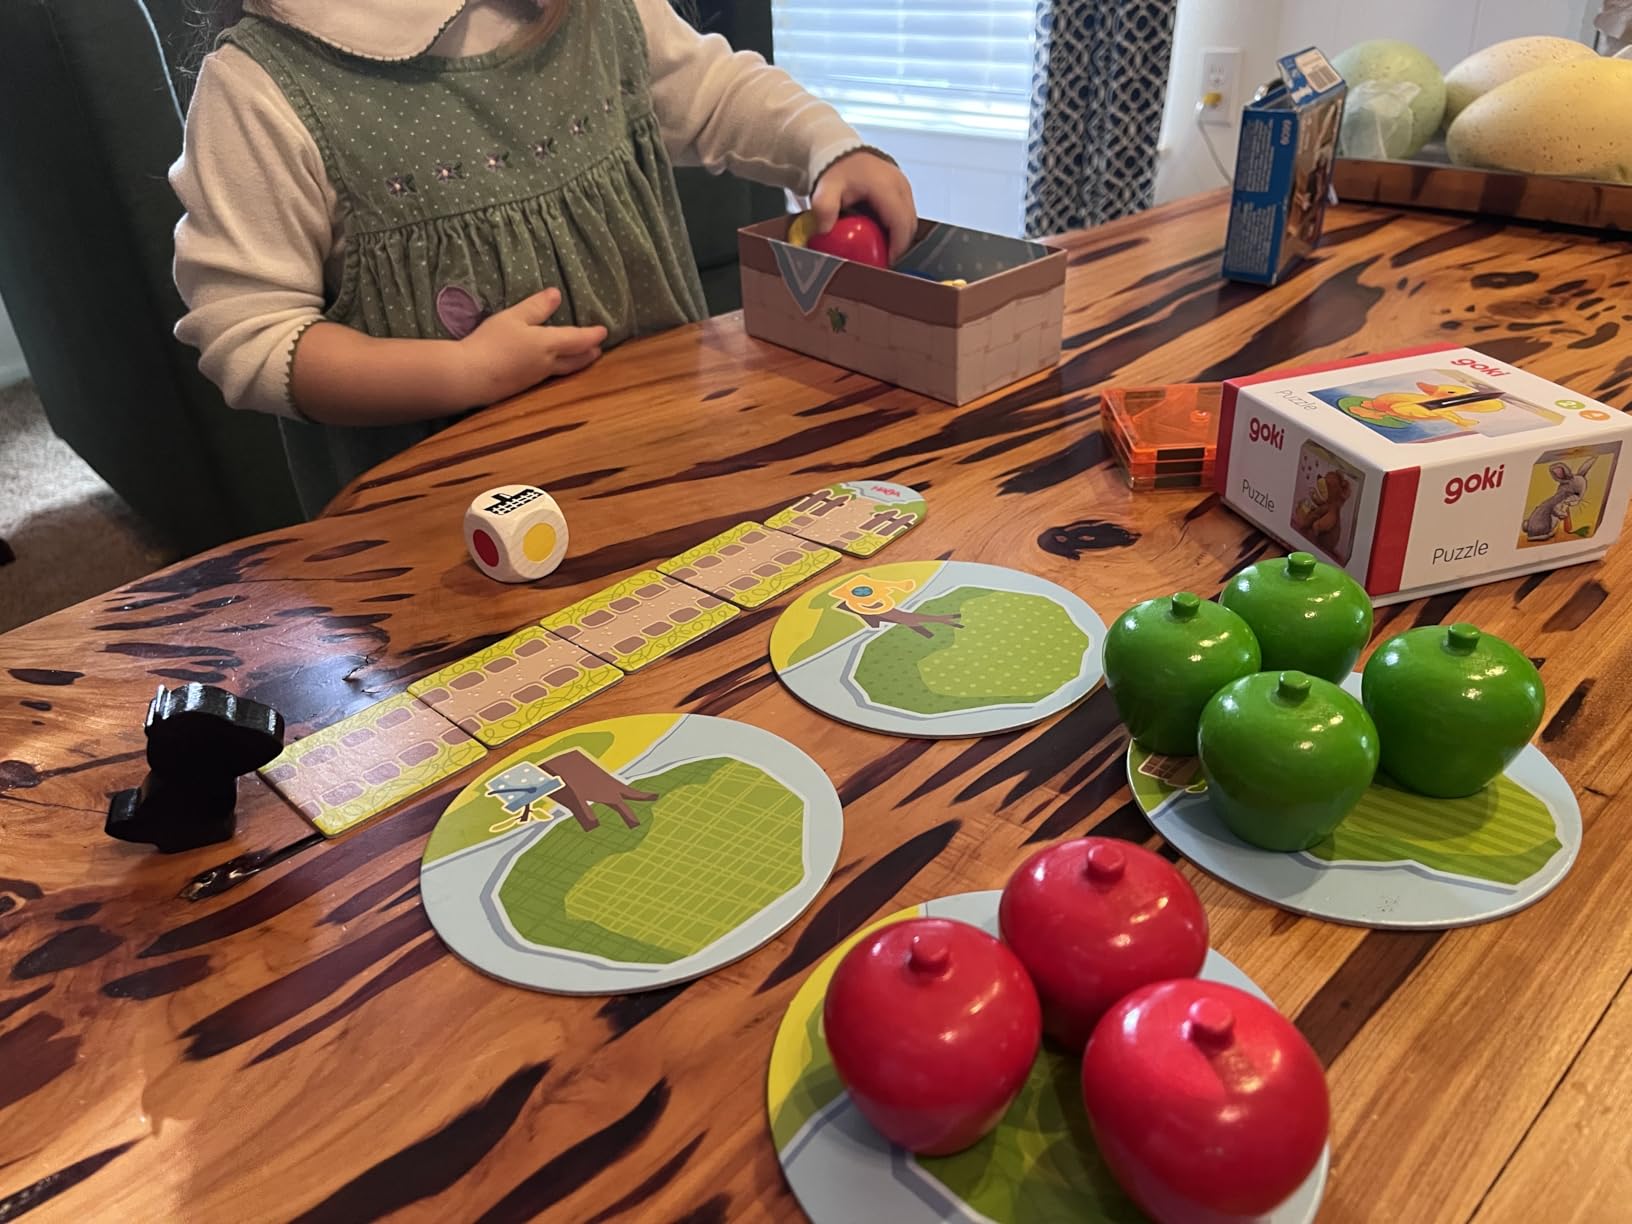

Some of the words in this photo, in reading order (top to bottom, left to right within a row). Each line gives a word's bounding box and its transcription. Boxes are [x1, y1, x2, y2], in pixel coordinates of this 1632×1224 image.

[1450, 358, 1511, 377] goki
[1275, 389, 1318, 411] Puzzle
[1249, 416, 1285, 451] goki
[1242, 478, 1275, 513] Puzzle
[1443, 464, 1505, 504] goki
[1432, 539, 1489, 565] Puzzle
